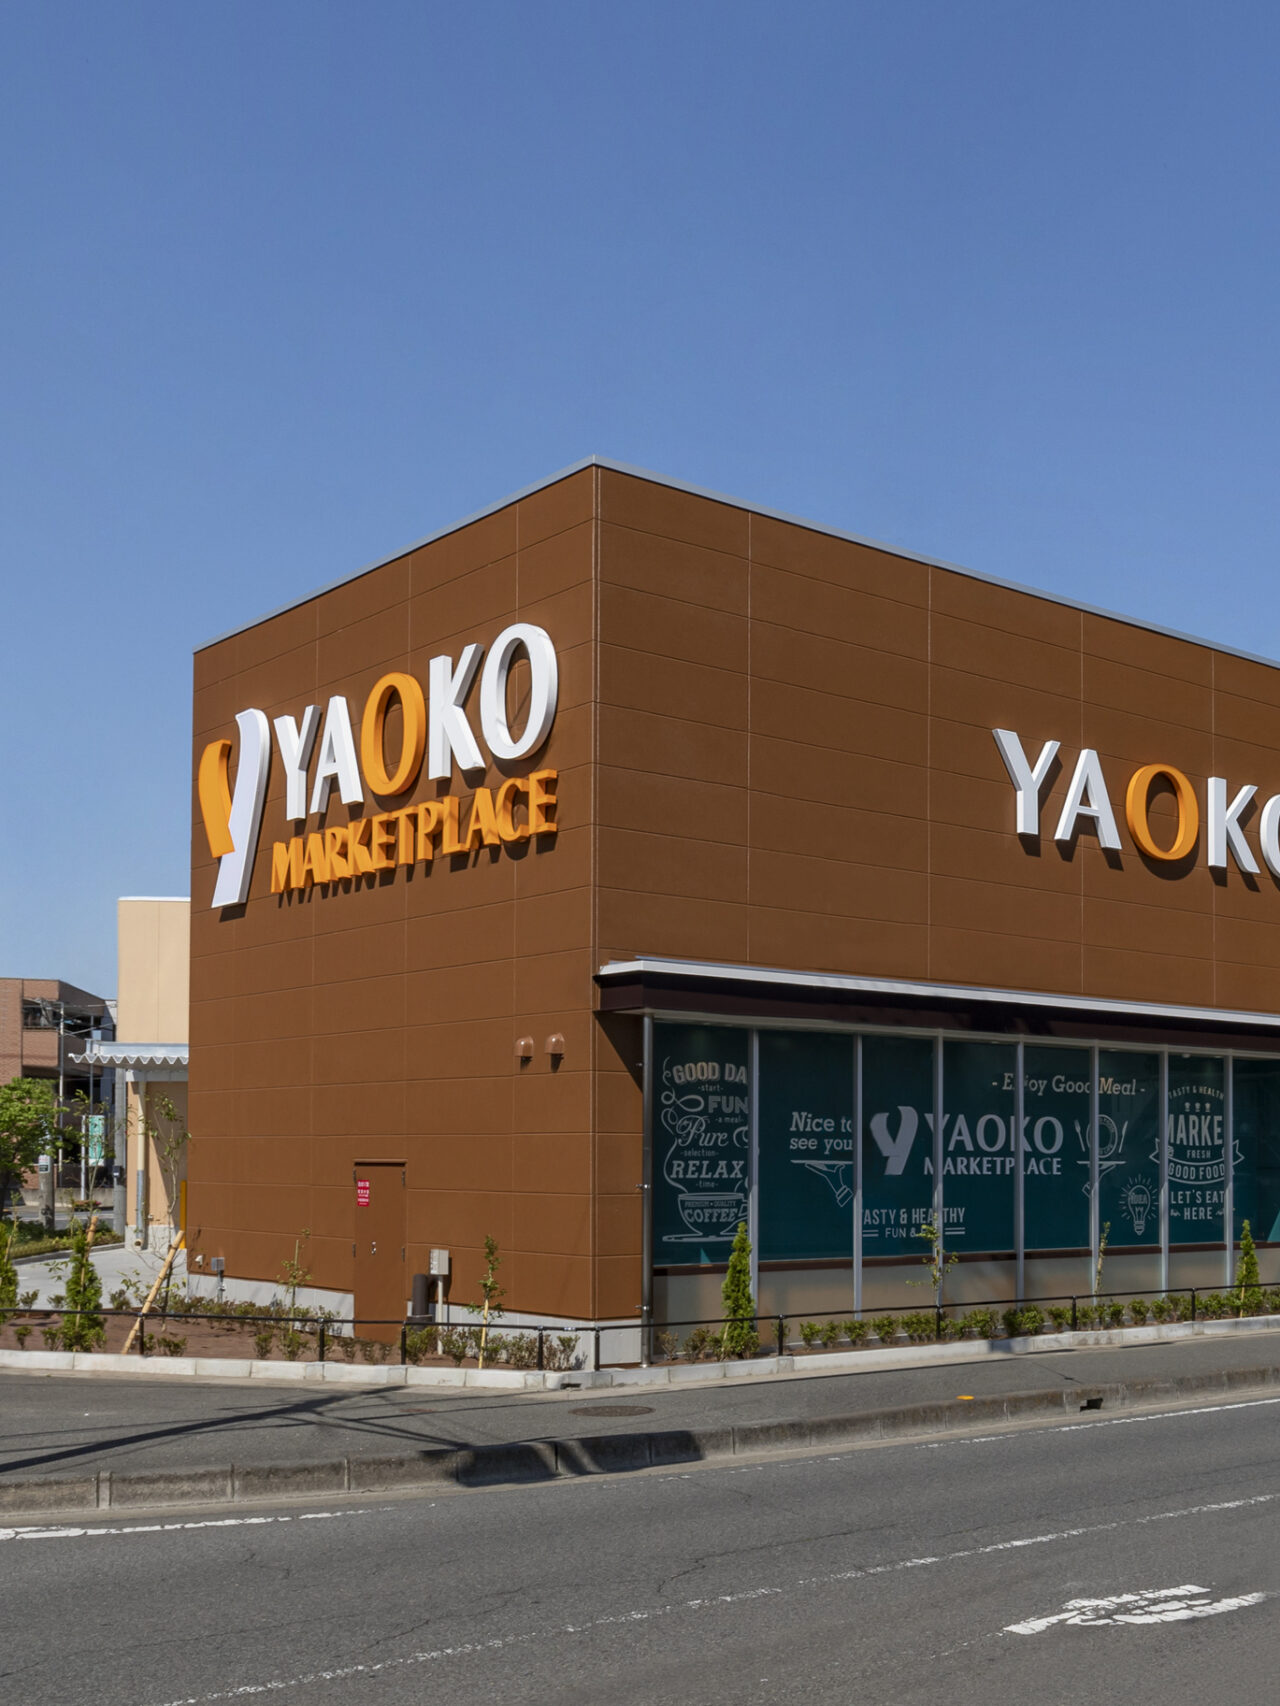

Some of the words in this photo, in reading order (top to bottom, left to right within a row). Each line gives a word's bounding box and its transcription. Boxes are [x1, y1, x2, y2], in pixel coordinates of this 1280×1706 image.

[273, 623, 558, 822] YAOKO
[270, 768, 558, 893] MARKETPLACE
[673, 1061, 720, 1085] GOOD
[724, 1063, 748, 1085] DA
[1001, 1072, 1048, 1096] Eoy
[1098, 1077, 1137, 1096] Meal
[1168, 1086, 1190, 1099] TASTY
[1199, 1086, 1225, 1100] HEALTH
[708, 1095, 749, 1114] FUN
[676, 1114, 729, 1147] Pure
[789, 1111, 835, 1132] Nice
[1168, 1113, 1223, 1146] MARKE
[924, 1112, 1064, 1154] YAOKO
[789, 1137, 818, 1150] see
[823, 1138, 854, 1155] you
[1186, 1150, 1211, 1159] FRESH
[670, 1160, 745, 1179] RELAX
[924, 1156, 1062, 1176] MARKETPACE
[1168, 1163, 1196, 1180] GOOD
[1199, 1163, 1225, 1180] FOOD
[713, 1199, 736, 1208] QUALITY
[1170, 1189, 1202, 1205] LET'S
[1205, 1190, 1225, 1204] EAT
[684, 1208, 738, 1223] COFFEE
[862, 1208, 896, 1225] ASTY
[900, 1208, 908, 1225] &
[912, 1207, 965, 1225] HEATHY
[1183, 1207, 1213, 1220] HERE
[885, 1227, 907, 1239] FUN
